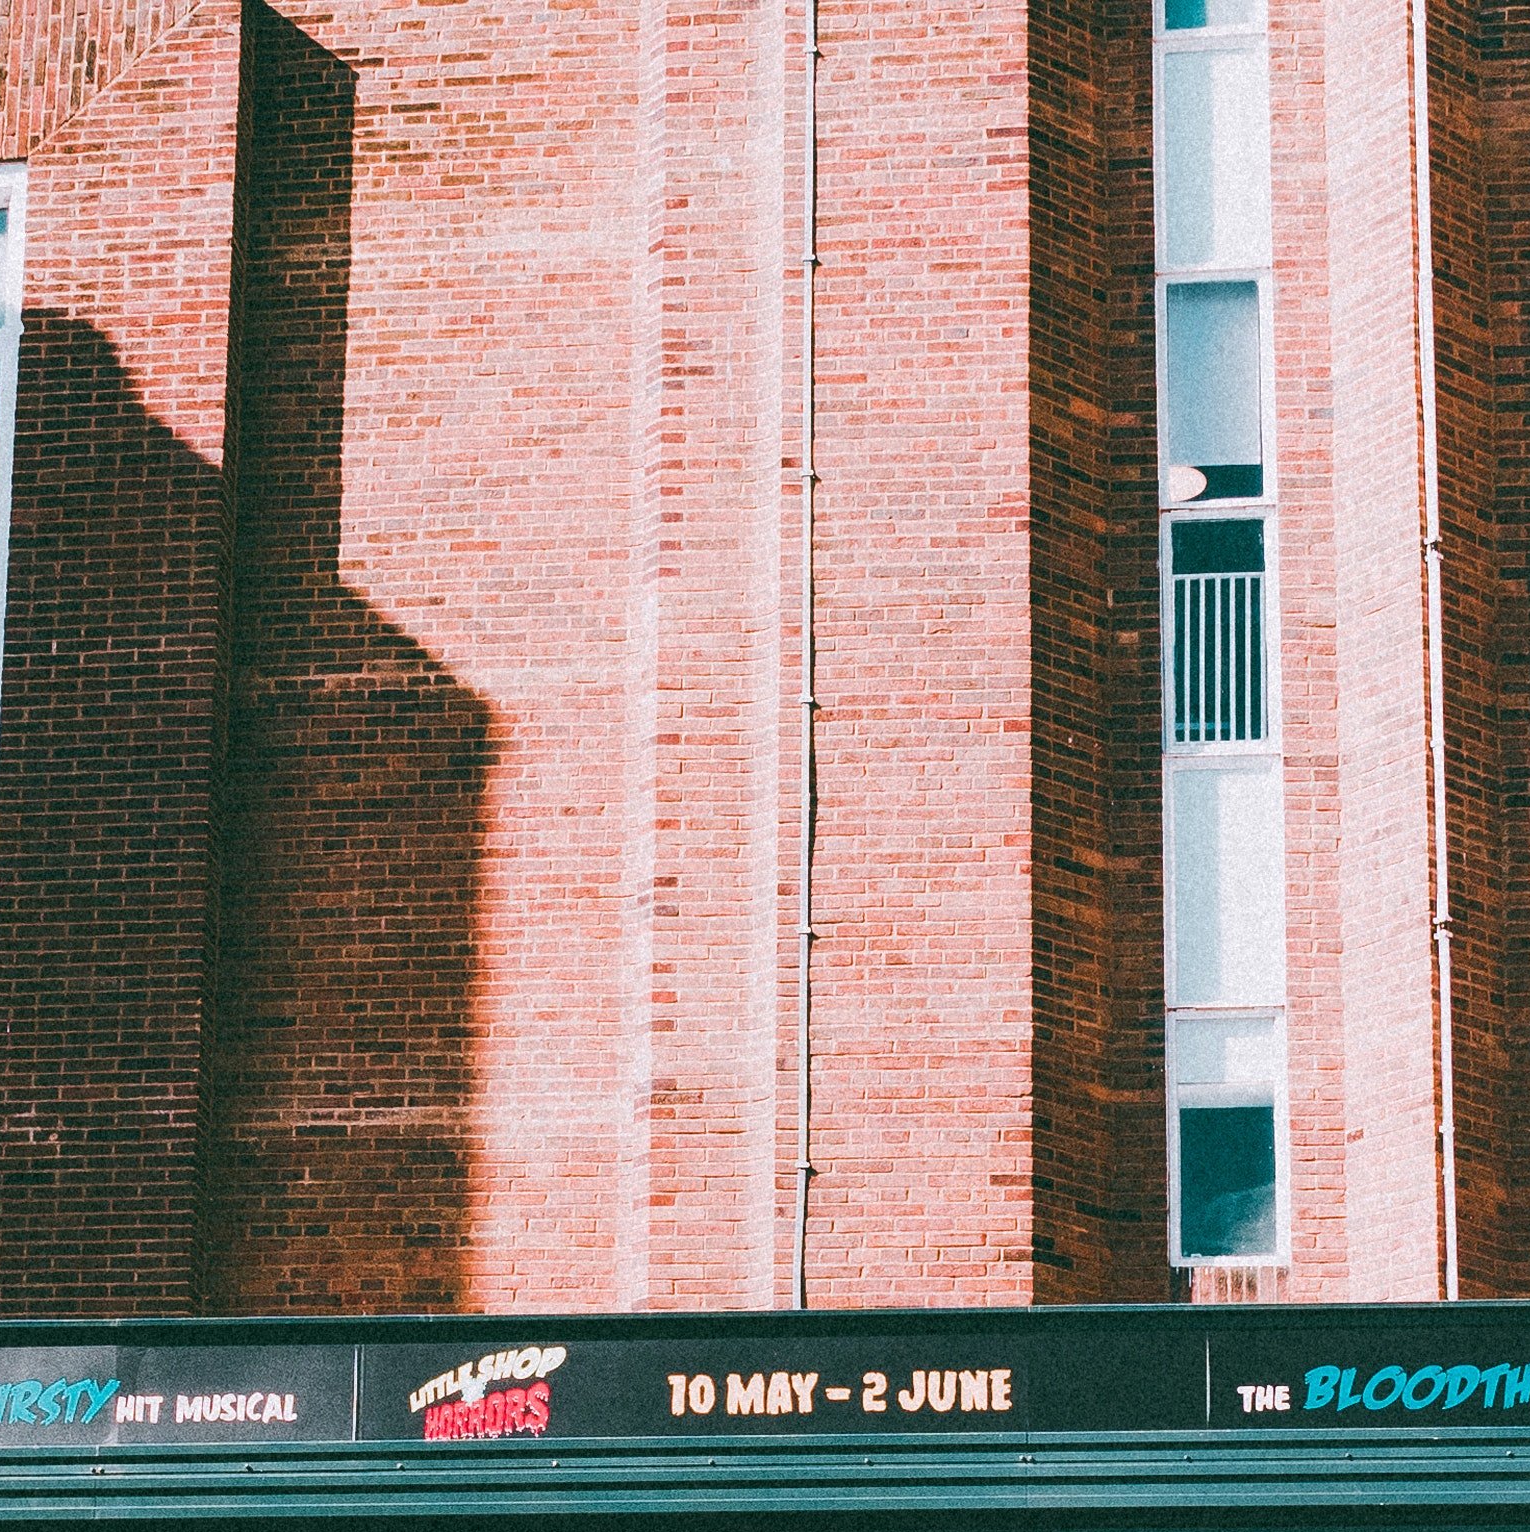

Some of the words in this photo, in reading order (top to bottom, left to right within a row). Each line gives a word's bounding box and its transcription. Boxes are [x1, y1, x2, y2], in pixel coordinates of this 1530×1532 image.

[476, 1345, 568, 1382] SHOP
[115, 1395, 165, 1425] HIT
[175, 1393, 298, 1424] MUSICAL
[424, 1381, 551, 1441] HORRORS
[668, 1373, 716, 1417] 10
[726, 1371, 820, 1416] MAY
[862, 1371, 888, 1414] 2
[898, 1368, 1014, 1414] JUNE
[1237, 1384, 1292, 1413] THE
